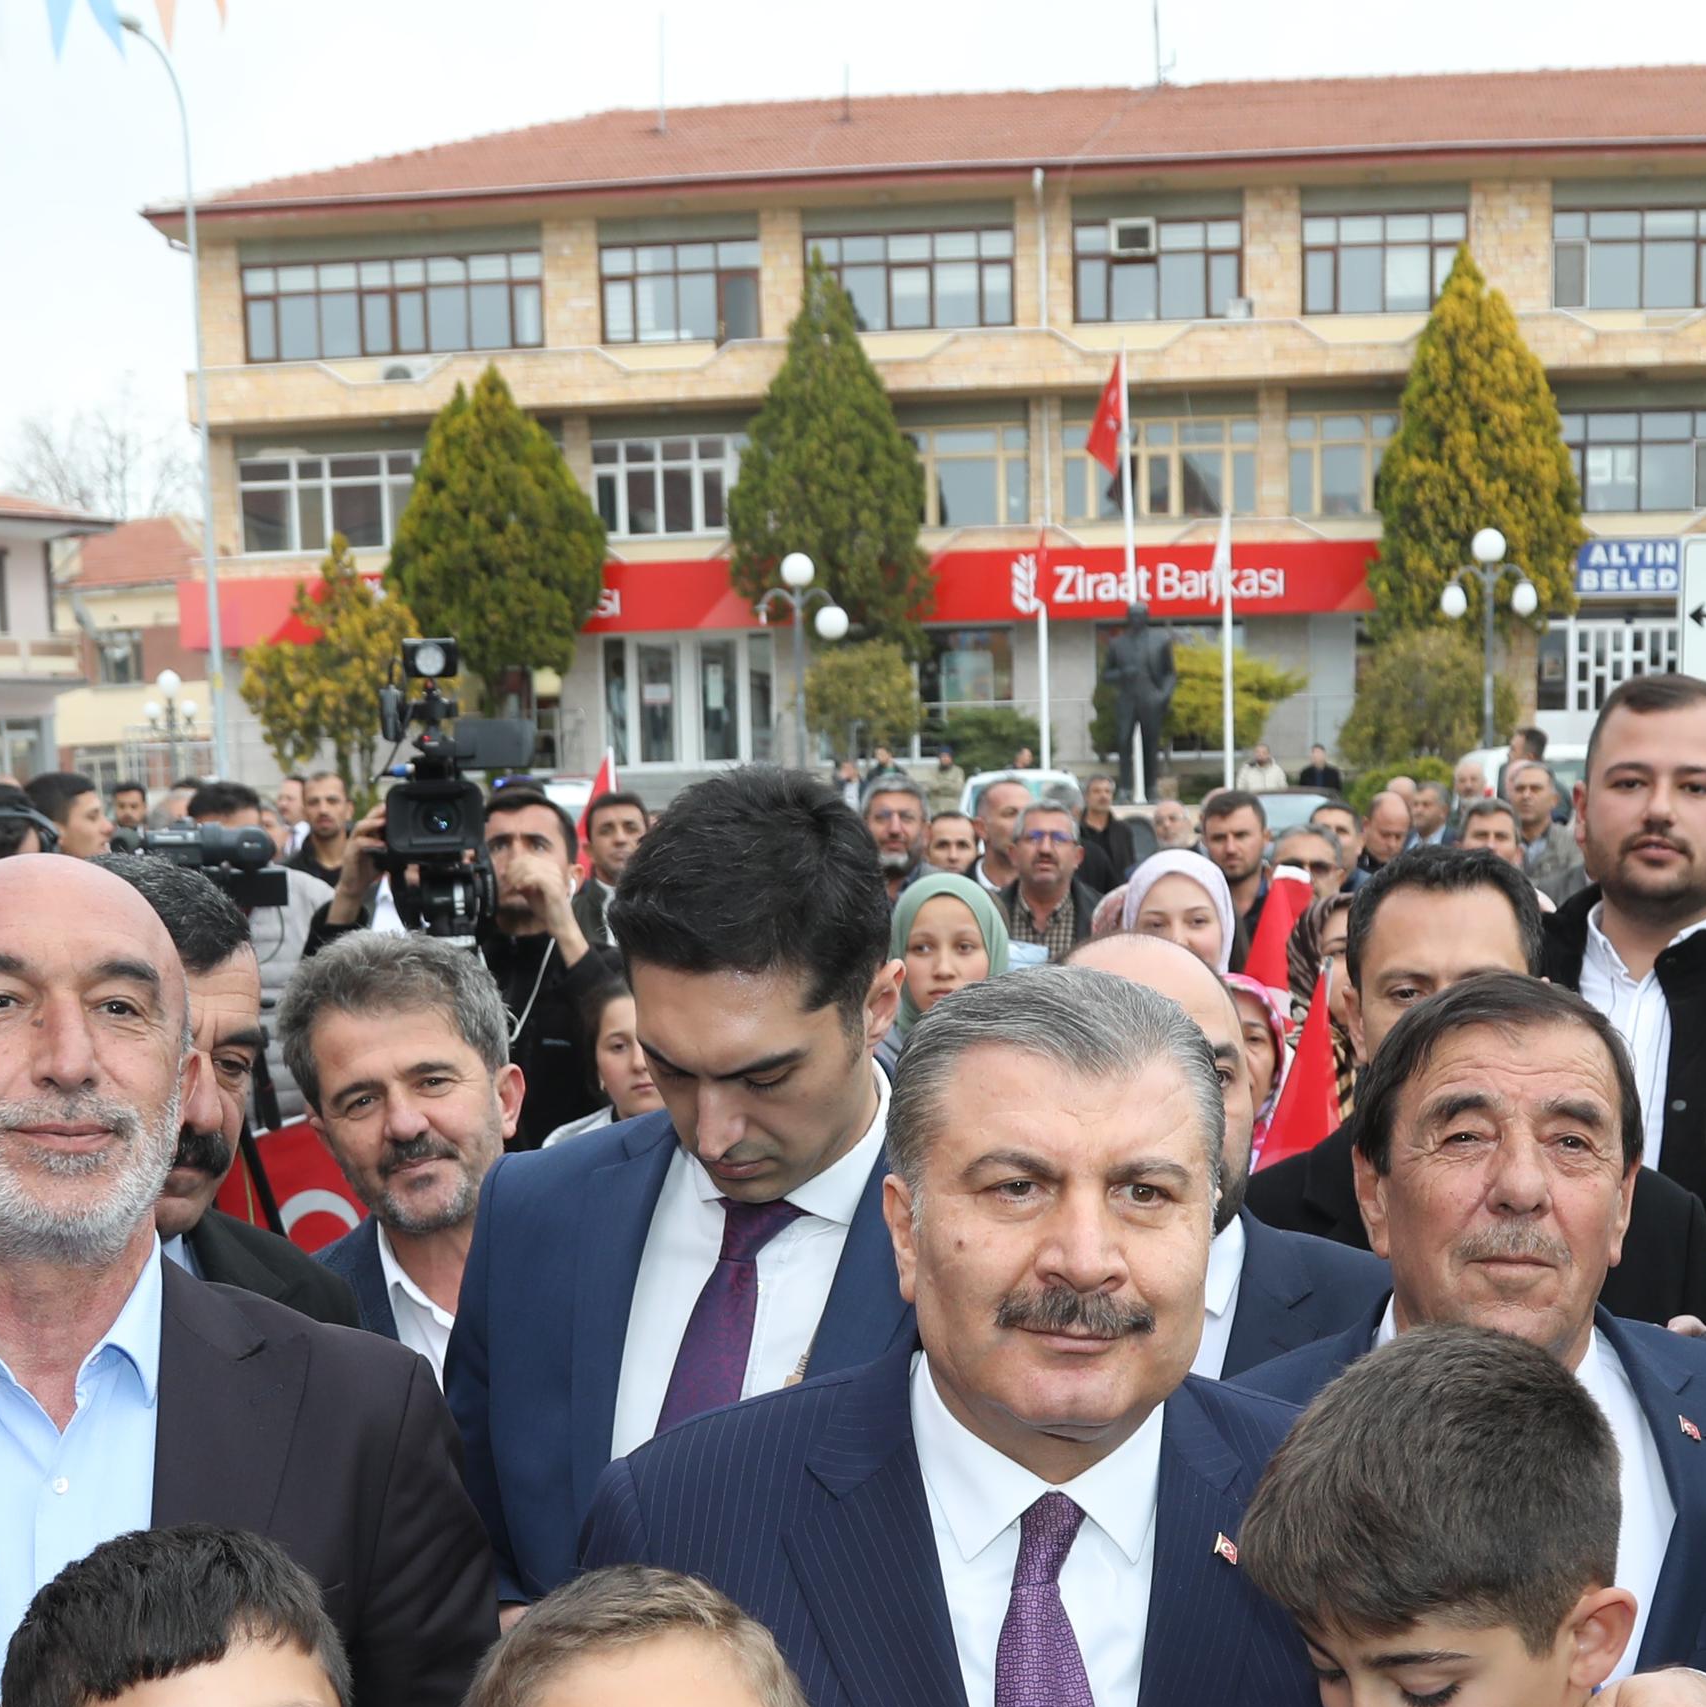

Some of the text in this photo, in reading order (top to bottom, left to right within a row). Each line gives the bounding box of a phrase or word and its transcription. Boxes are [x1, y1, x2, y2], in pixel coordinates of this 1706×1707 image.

[1589, 544, 1676, 567] ALTIN
[1053, 562, 1284, 602] Ziraat Bankası
[1580, 568, 1678, 591] BELED
